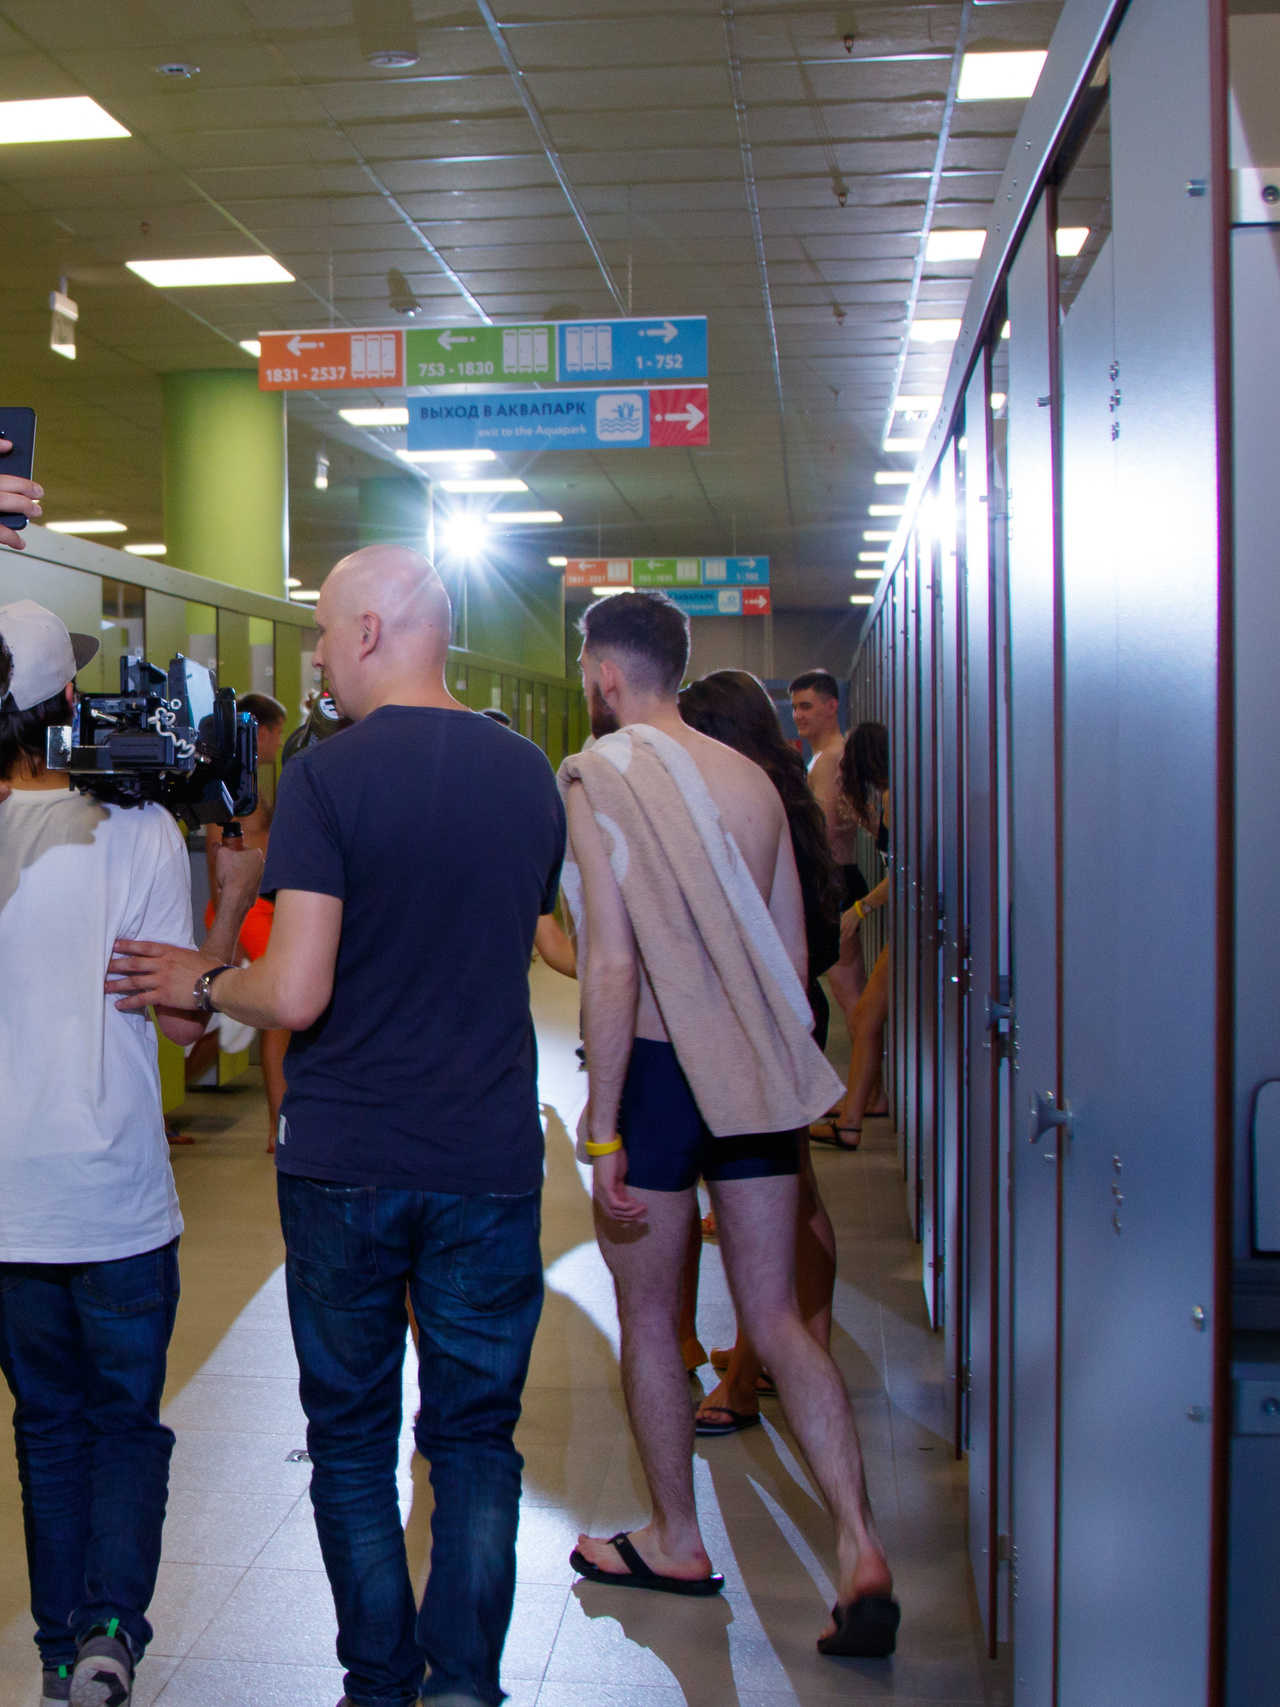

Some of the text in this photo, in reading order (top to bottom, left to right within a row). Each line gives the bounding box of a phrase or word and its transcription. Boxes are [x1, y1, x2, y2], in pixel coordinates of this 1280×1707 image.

[418, 363, 445, 377] 753
[458, 361, 494, 376] 1830
[655, 354, 684, 369] 752
[266, 368, 299, 382] 1831
[420, 402, 587, 420] ВЫХОД В АКВАПАРК
[478, 424, 587, 438] exit to the Aquapark
